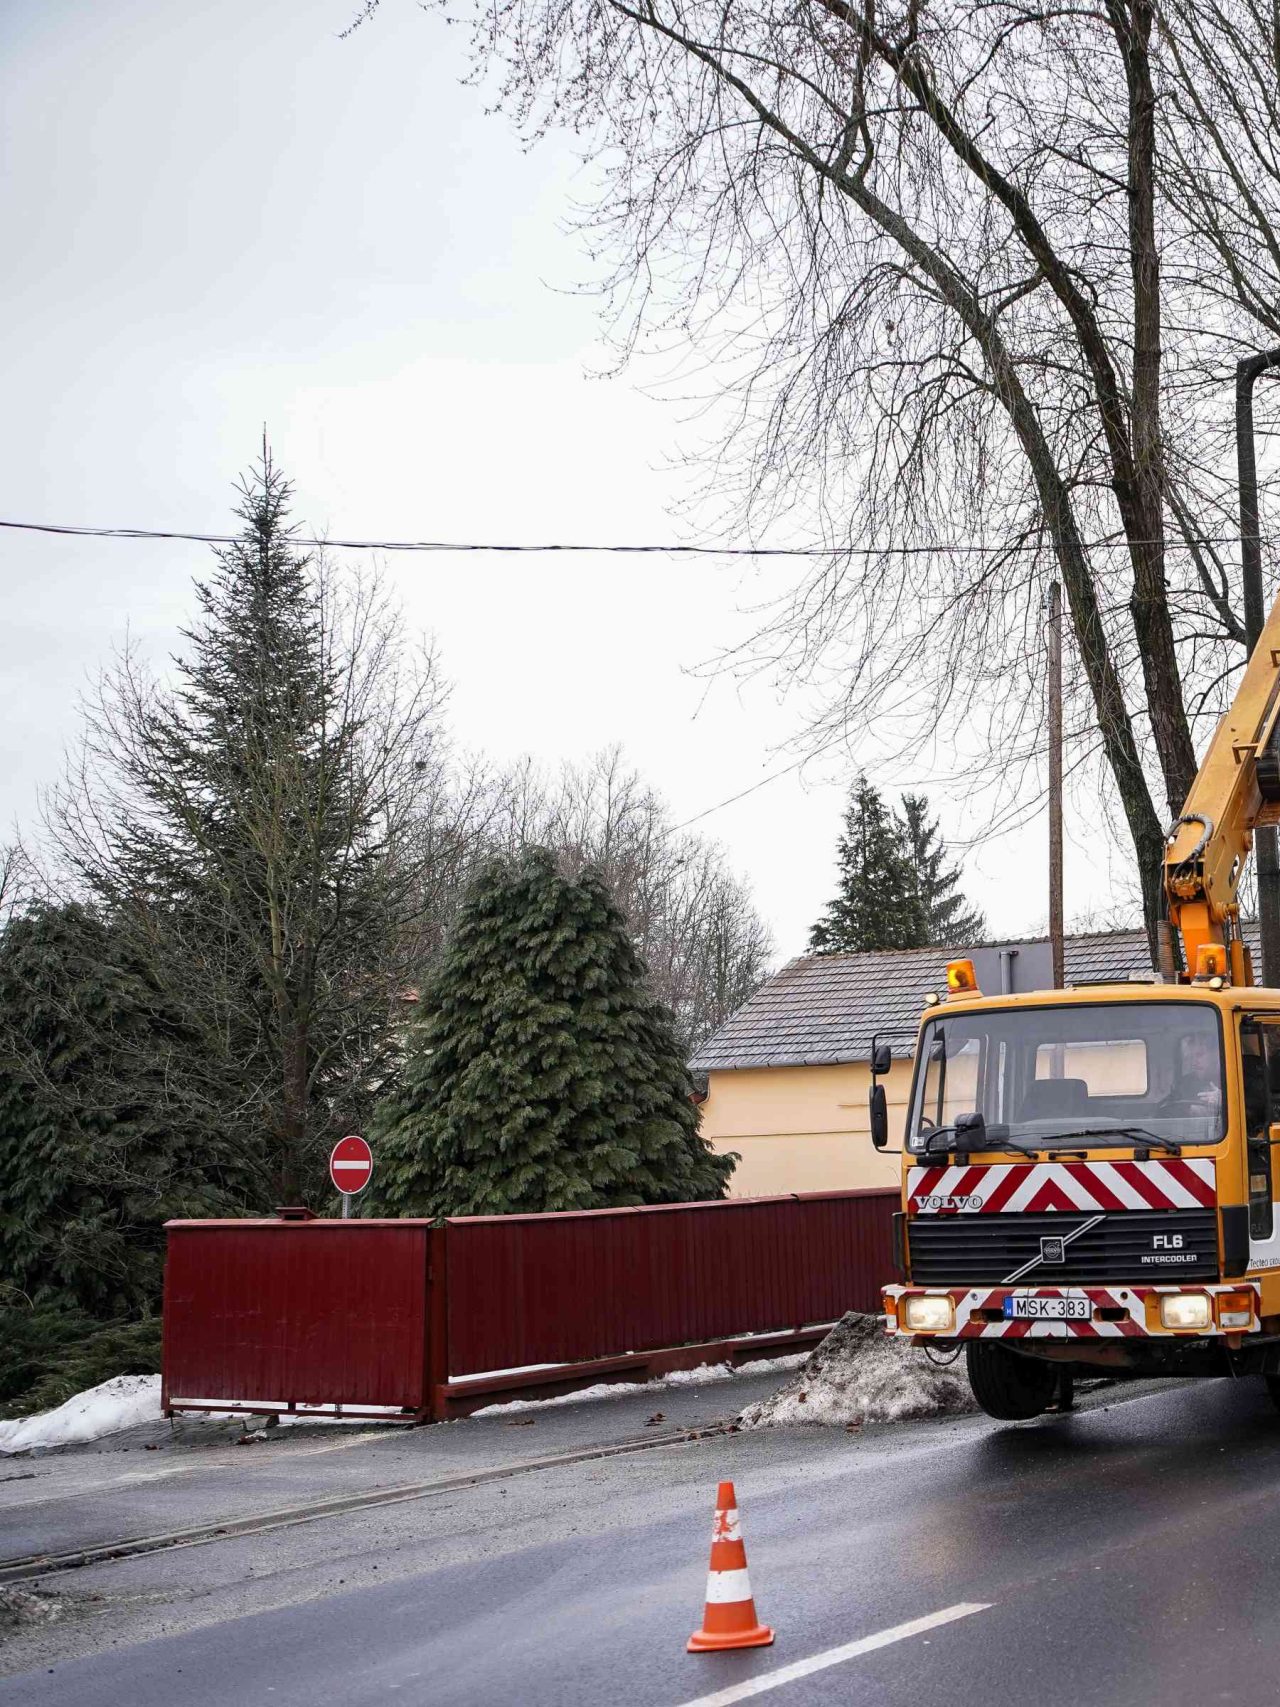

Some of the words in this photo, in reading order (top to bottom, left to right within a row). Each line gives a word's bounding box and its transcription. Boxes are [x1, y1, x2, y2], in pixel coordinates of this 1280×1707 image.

[913, 1195, 984, 1209] VOLVO
[1153, 1234, 1183, 1249] FL6
[1141, 1254, 1198, 1264] INTERCOOLER
[1016, 1300, 1085, 1316] MSK-383
